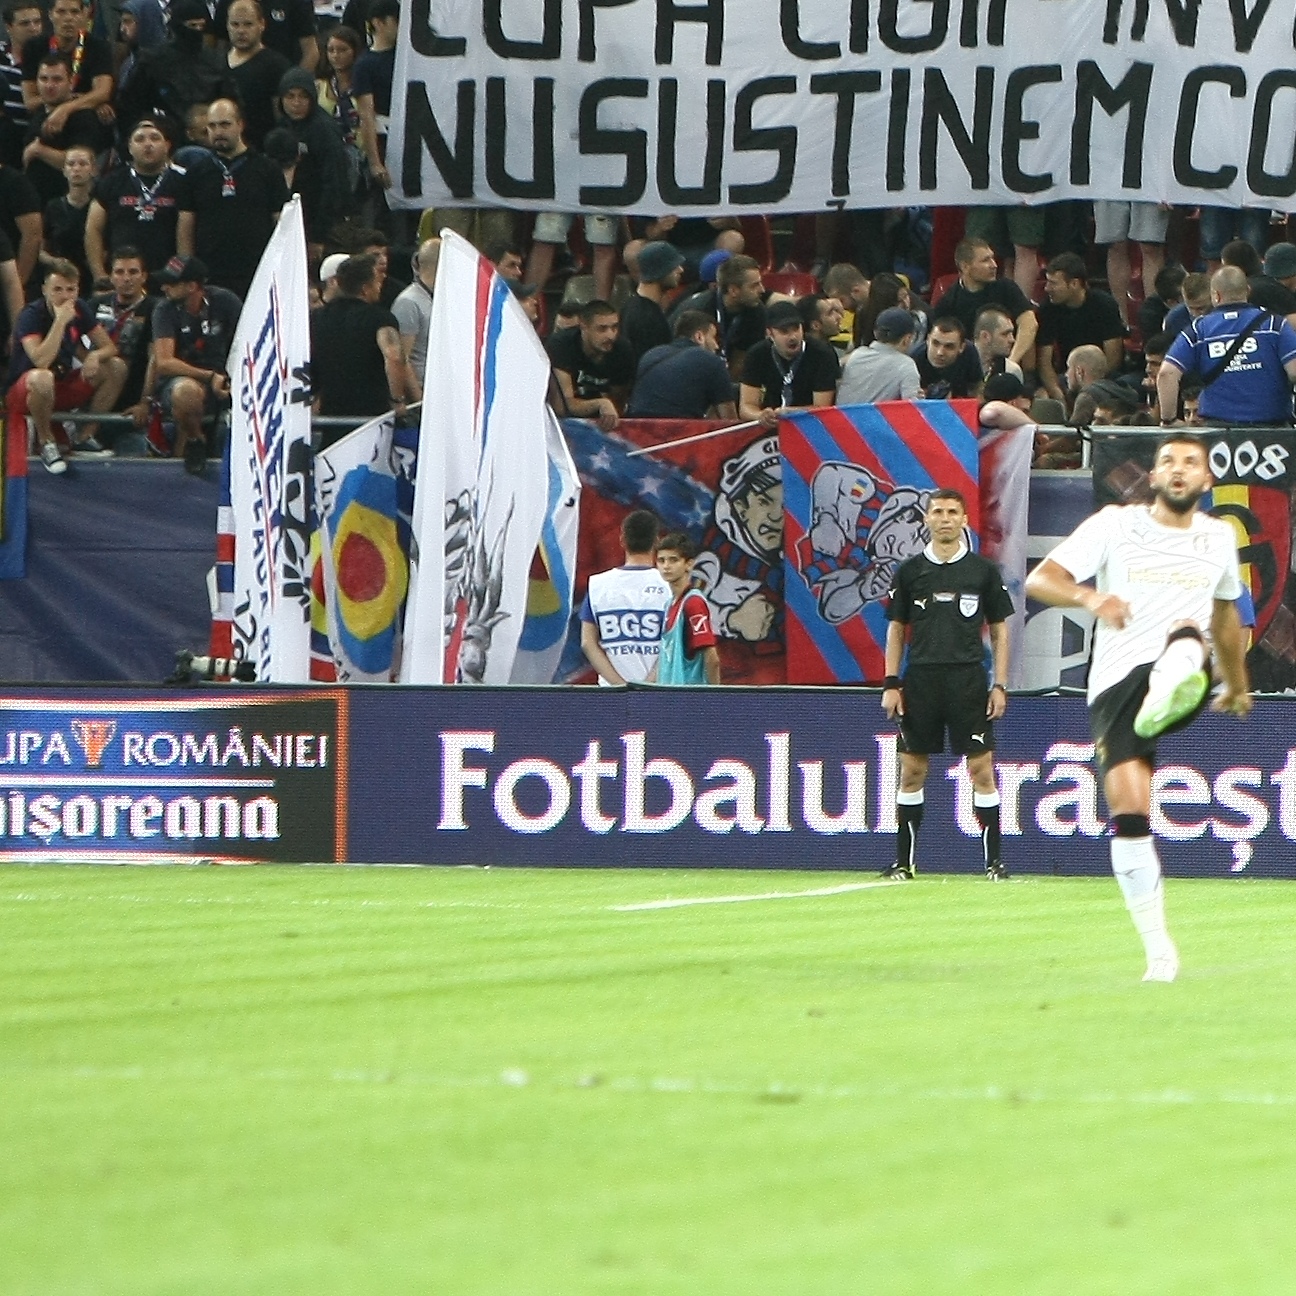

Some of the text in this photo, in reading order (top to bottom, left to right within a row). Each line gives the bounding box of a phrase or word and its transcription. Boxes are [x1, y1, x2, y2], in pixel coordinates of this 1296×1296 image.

[400, 77, 556, 201] NU
[1208, 442, 1290, 481] 008
[600, 612, 662, 643] BGS
[123, 725, 329, 768] ROMÂNIEI
[436, 729, 899, 836] Fotbalul
[0, 790, 282, 846] ișoreana
